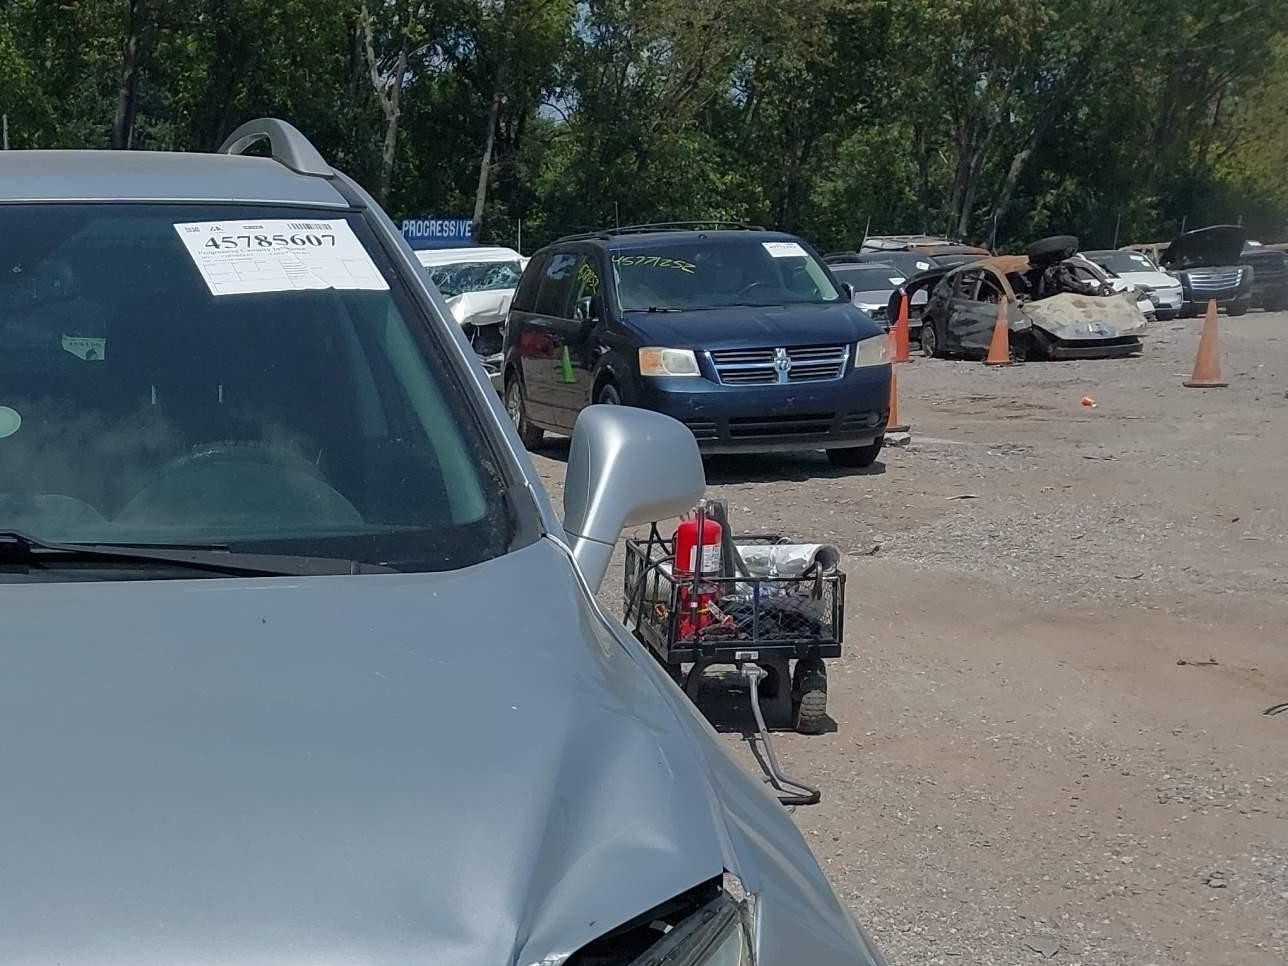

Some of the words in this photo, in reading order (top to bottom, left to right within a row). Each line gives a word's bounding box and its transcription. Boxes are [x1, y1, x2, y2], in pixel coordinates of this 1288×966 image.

[401, 219, 473, 237] PROGRESSIVE
[204, 233, 337, 249] 45785607
[611, 255, 697, 274] 45771252
